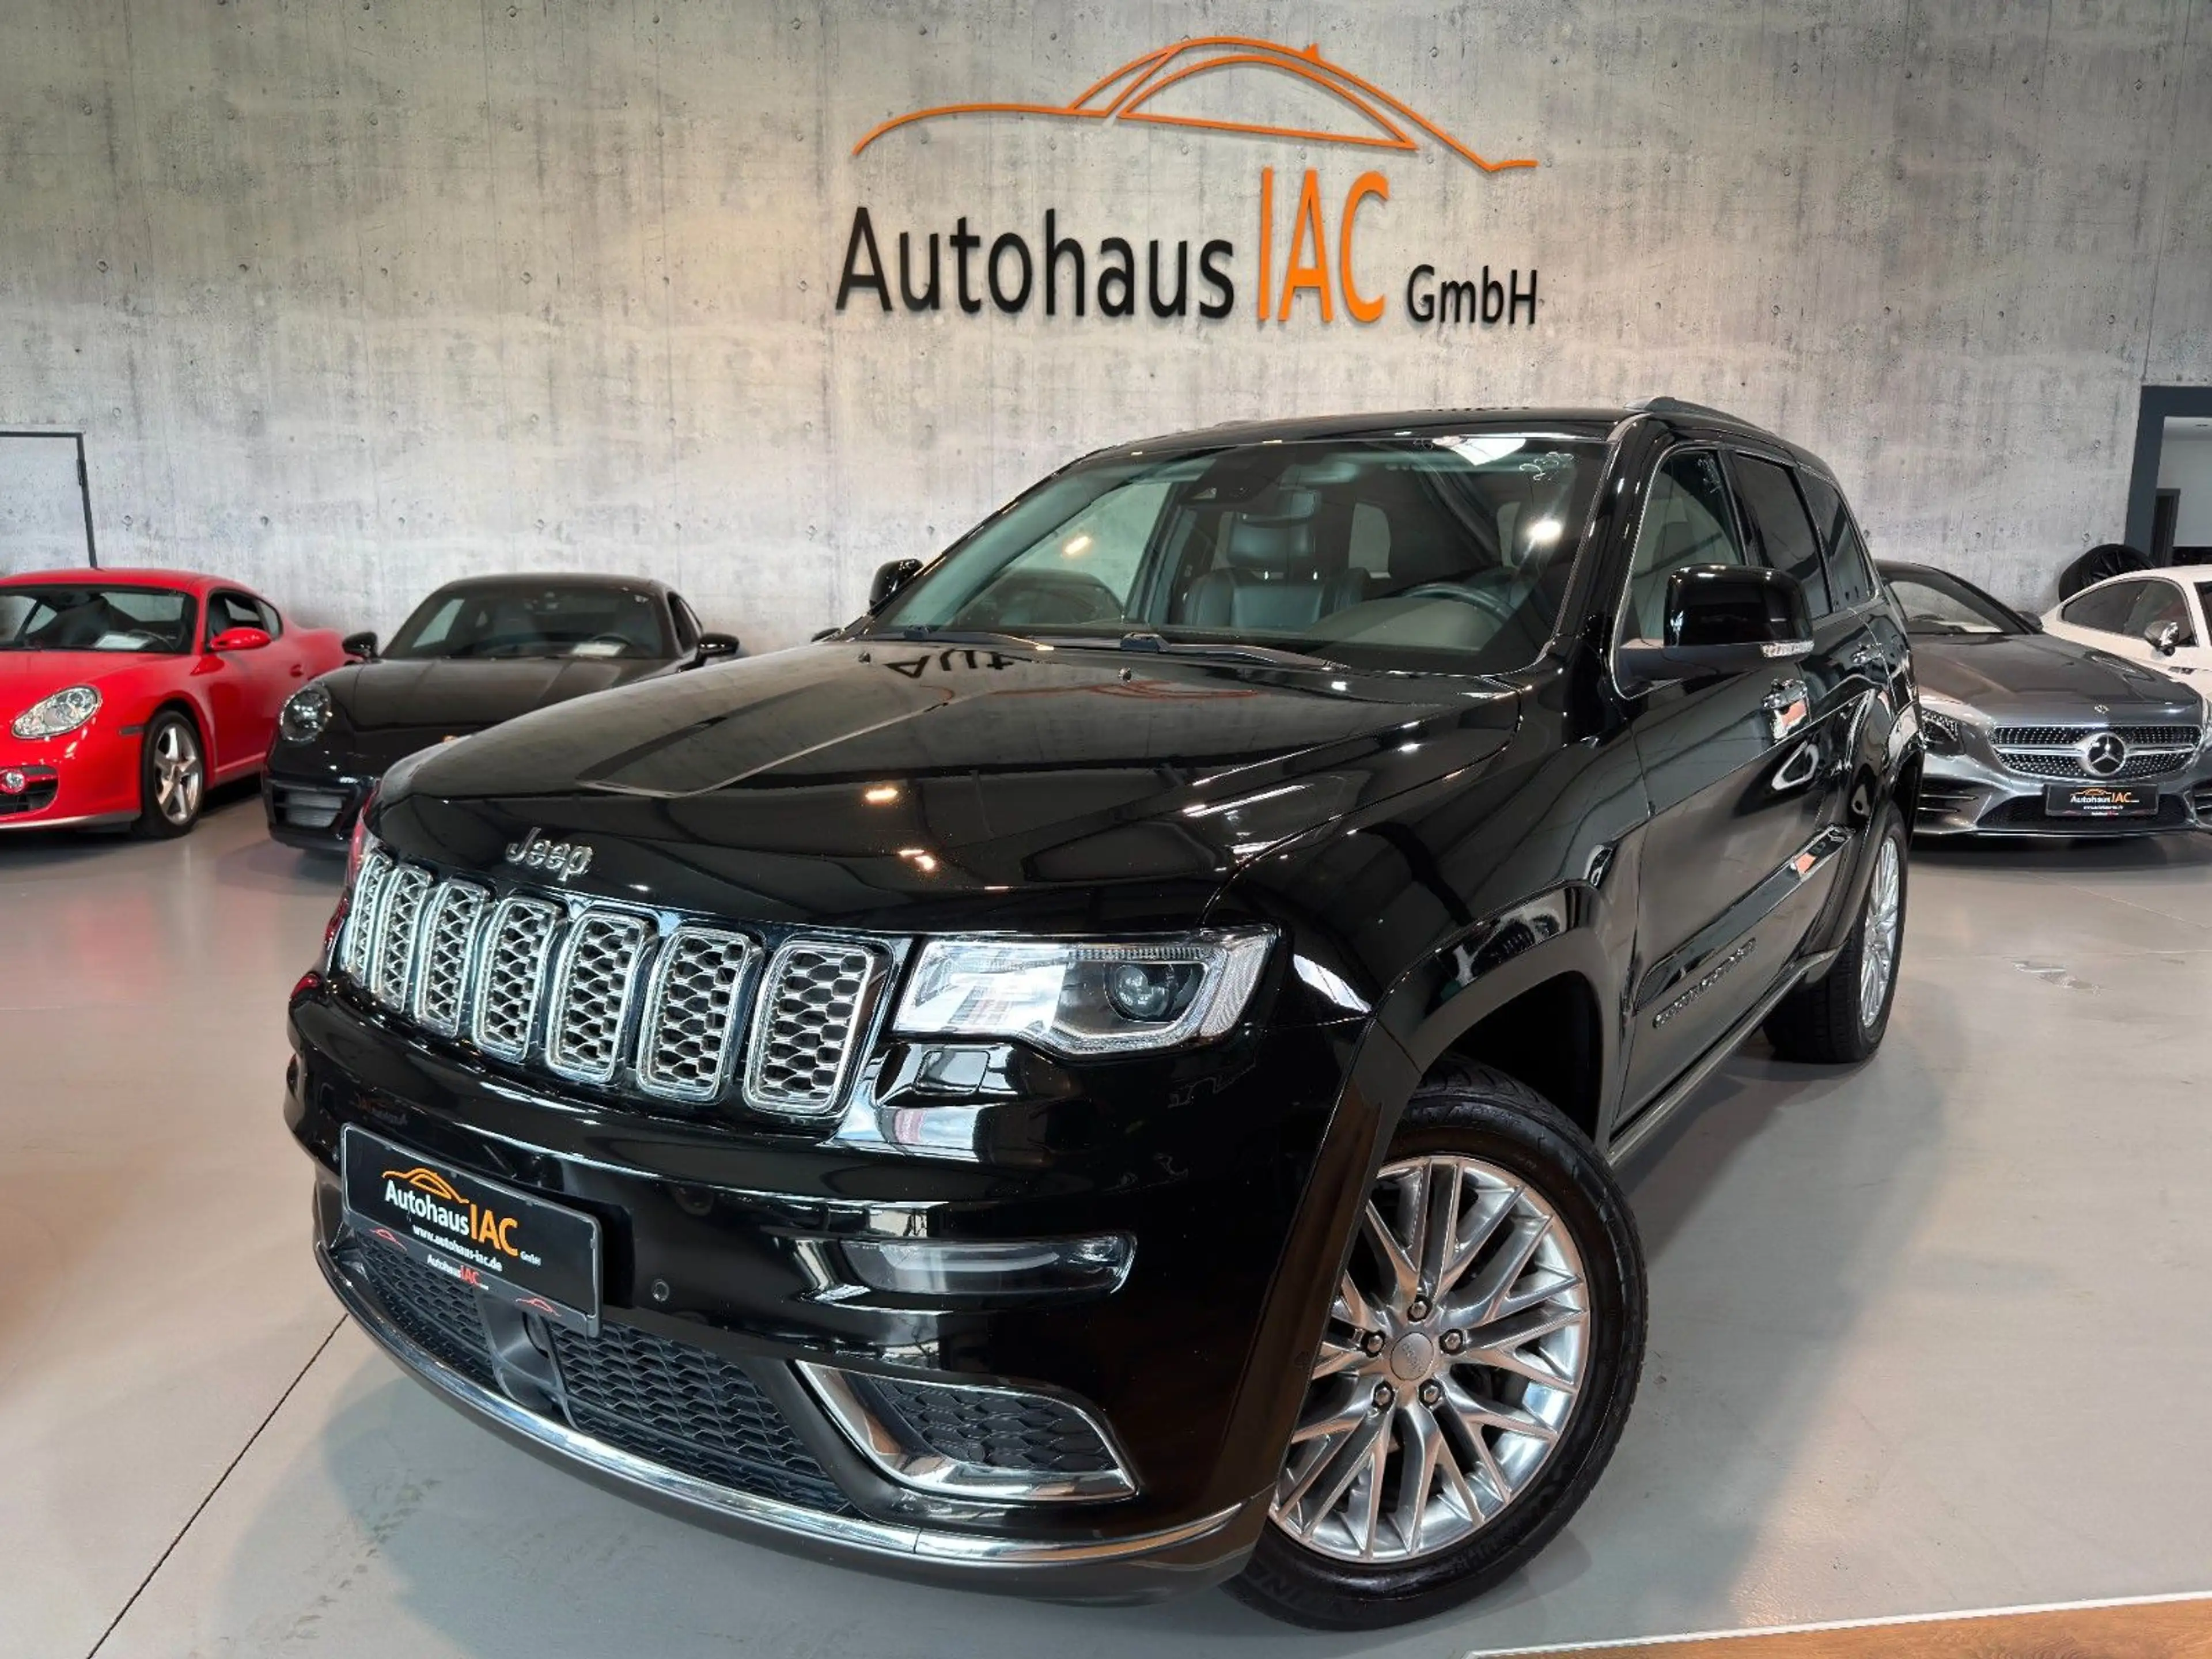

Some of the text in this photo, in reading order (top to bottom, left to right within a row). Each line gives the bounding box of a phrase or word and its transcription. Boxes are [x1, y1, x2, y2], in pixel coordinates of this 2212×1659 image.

[835, 167, 1537, 325] Autohaus IAC GmbH
[505, 827, 593, 881] Jeep
[385, 1179, 469, 1236] Autohaus
[470, 1204, 518, 1256] IAC
